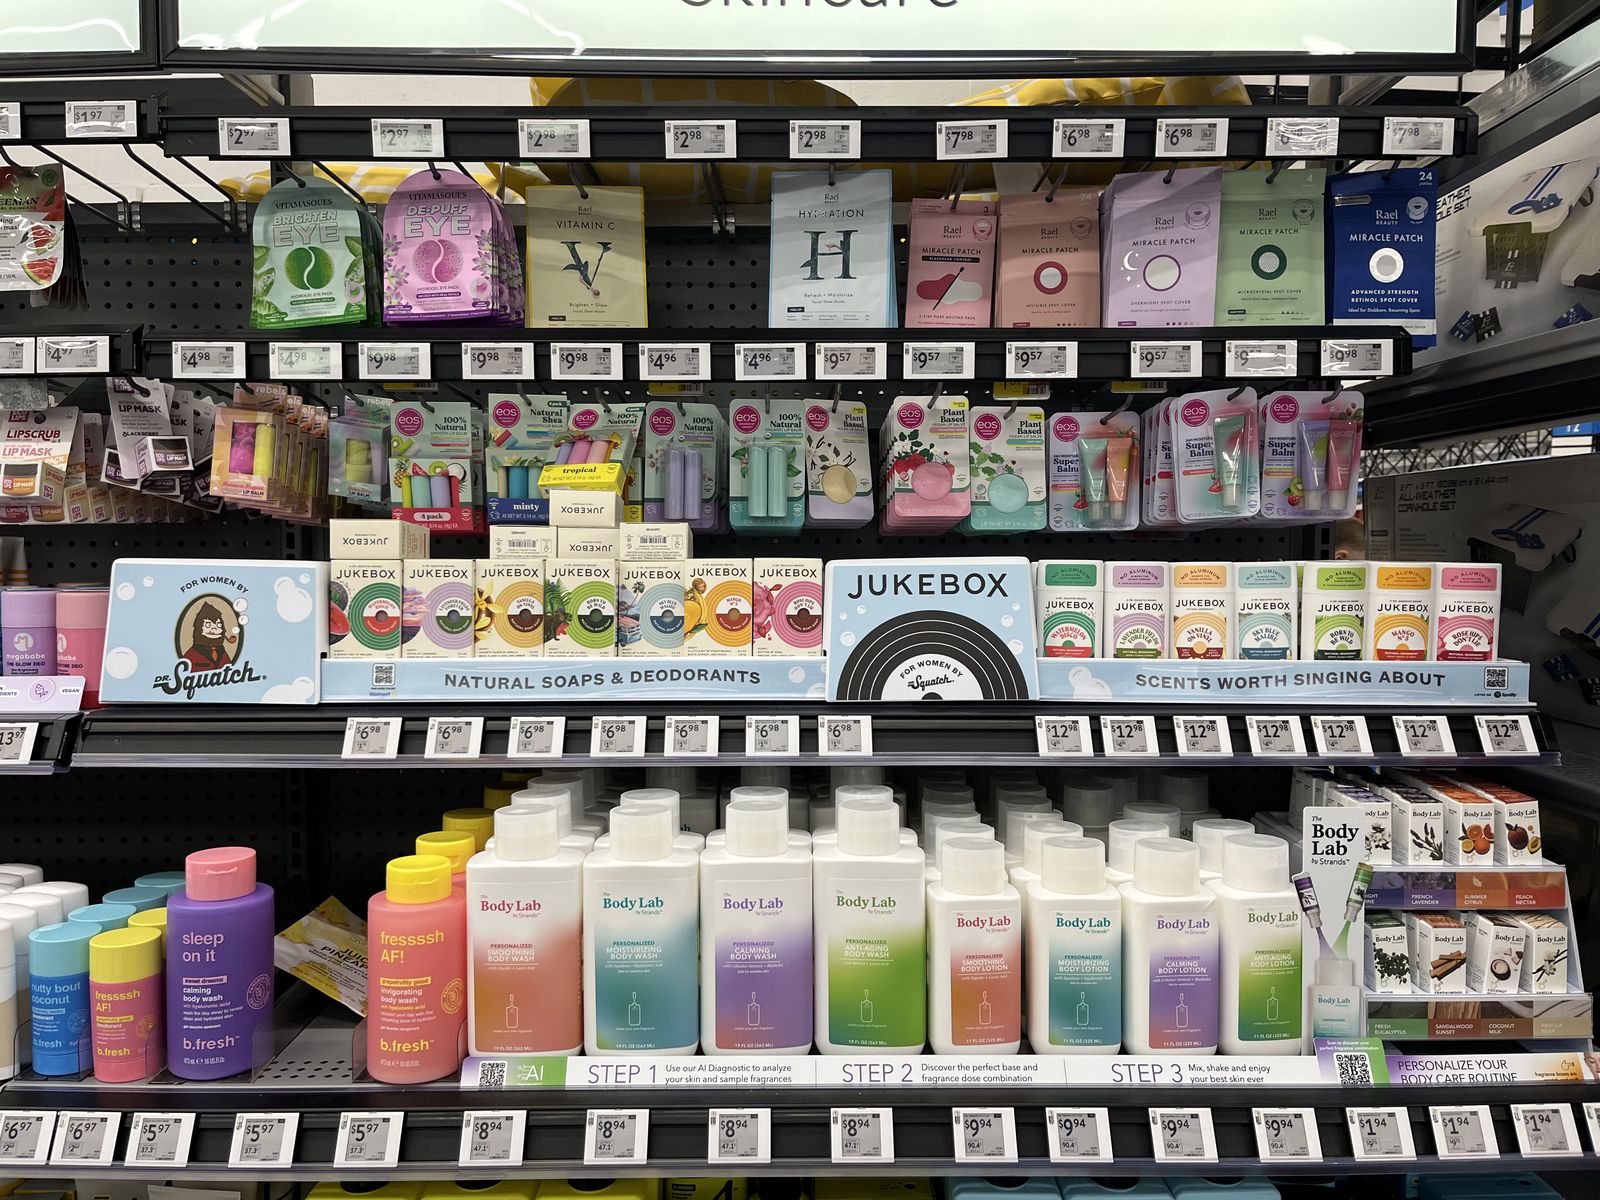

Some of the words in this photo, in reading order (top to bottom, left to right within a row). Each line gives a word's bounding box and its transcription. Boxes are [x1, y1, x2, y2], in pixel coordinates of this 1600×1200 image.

[1419, 172, 1433, 182] 24
[409, 191, 467, 201] VITAMASQUES
[276, 199, 333, 210] VITAMASQUES
[407, 204, 468, 216] DE-PUFF
[798, 209, 864, 219] HYDRATION
[1258, 208, 1277, 219] Rael
[1375, 209, 1398, 220] Rael
[273, 211, 337, 226] BRIGHTEN
[1155, 217, 1174, 226] Rael
[404, 215, 471, 238] EYE
[556, 220, 603, 230] VITAMIN
[608, 222, 615, 231] C
[944, 225, 962, 235] Rael
[273, 221, 340, 247] EYE
[1239, 227, 1272, 236] MIRACLE
[1275, 227, 1299, 235] PATCH
[1133, 239, 1167, 247] MIRACLE
[1170, 238, 1196, 246] PATCH
[1349, 233, 1392, 242] MIRACLE
[1395, 233, 1423, 242] PATCH
[255, 385, 286, 395] rebels
[496, 407, 517, 417] eos
[530, 408, 563, 418] Natural
[942, 409, 965, 417] Plant
[1274, 404, 1296, 413] eos
[901, 410, 921, 419] eos
[398, 415, 420, 425] eos
[443, 416, 467, 424] 100%
[542, 416, 562, 424] Shea
[434, 423, 467, 431] Natural
[7, 429, 61, 440] LIPSCRUB
[1268, 441, 1295, 450] Super
[3, 447, 19, 456] LIP
[21, 447, 53, 456] MASK
[1272, 448, 1295, 456] Balm
[562, 466, 597, 476] tropical
[1400, 489, 1457, 501] ALL-WEATHER
[513, 503, 539, 512] minty
[1438, 501, 1456, 511] SET
[337, 569, 396, 579] JUKEBOX
[690, 568, 747, 578] JUKEBOX
[760, 568, 817, 578] JUKEBOX
[180, 579, 199, 593] FOR
[200, 576, 237, 586] WOMEN
[236, 583, 249, 594] BY
[848, 572, 1008, 599] JUKEBOX
[1045, 601, 1094, 610] JUKEBOX
[1176, 599, 1225, 608] JUKEBOX
[1441, 604, 1494, 614] JUKEBOX
[1051, 626, 1087, 640] WATERMELON
[1060, 632, 1078, 640] DISCO
[1187, 627, 1212, 636] VANILLA
[6, 653, 46, 661] megababe
[900, 665, 916, 679] FOR
[917, 660, 951, 670] WOMEN
[951, 668, 964, 678] BY
[154, 674, 172, 683] DR.
[160, 657, 261, 699] Squatch
[444, 674, 535, 689] NATURAL
[542, 672, 604, 688] SOAPS
[611, 673, 624, 684] &
[630, 669, 761, 685] DEODORANTS
[908, 675, 952, 691] Squatch
[1136, 674, 1211, 690] SCENTS
[1217, 674, 1287, 690] WORTH
[1294, 671, 1372, 686] SINGING
[1379, 671, 1446, 687] ABOUT
[1312, 824, 1359, 841] Body
[1312, 841, 1347, 856] Lab
[480, 900, 514, 913] Body
[516, 900, 541, 911] Lab
[603, 897, 637, 911] Body
[639, 897, 663, 909] Lab
[723, 898, 756, 911] Body
[759, 897, 784, 909] Lab
[836, 896, 869, 909] Body
[872, 896, 896, 908] Lab
[183, 931, 225, 946] sleep
[380, 929, 444, 946] fressssh
[183, 950, 200, 962] on
[206, 948, 215, 962] it
[380, 949, 405, 964] AF!
[183, 986, 211, 995] calming
[380, 987, 423, 996] invigorating
[183, 994, 202, 1003] body
[204, 994, 223, 1002] wash
[183, 1034, 235, 1050] b.fresh
[380, 1038, 430, 1052] b.fresh
[666, 1064, 681, 1073] Use
[698, 1064, 707, 1072] AI
[708, 1063, 750, 1075] Diagnostic
[752, 1065, 760, 1073] to
[762, 1063, 792, 1075] analyze
[921, 1063, 955, 1072] Discover
[957, 1063, 970, 1072] the
[972, 1063, 1001, 1074] perfect
[1003, 1063, 1020, 1072] base
[1023, 1063, 1038, 1072] and
[1189, 1064, 1204, 1074] Mix,
[1206, 1064, 1228, 1072] shake
[1231, 1064, 1246, 1072] and
[1249, 1064, 1270, 1075] enjoy
[1399, 1060, 1471, 1071] PERSONALIZE
[1474, 1060, 1507, 1070] YOUR
[588, 1064, 640, 1084] STEP
[649, 1065, 656, 1083] 1
[842, 1063, 894, 1083] STEP
[902, 1063, 913, 1082] 2
[1111, 1064, 1163, 1083] STEP
[1171, 1064, 1183, 1083] 3
[1401, 1073, 1433, 1083] BODY
[1436, 1073, 1465, 1083] CARE
[1467, 1073, 1517, 1083] ROUTINE
[665, 1076, 683, 1085] your
[685, 1074, 701, 1083] skin
[703, 1074, 718, 1083] and
[720, 1074, 748, 1085] sample
[750, 1074, 792, 1085] fragrances
[922, 1074, 959, 1084] fragrance
[962, 1074, 980, 1083] dose
[982, 1074, 1033, 1083] combination
[1189, 1076, 1211, 1085] your
[1214, 1074, 1229, 1083] best
[1231, 1074, 1245, 1083] skin
